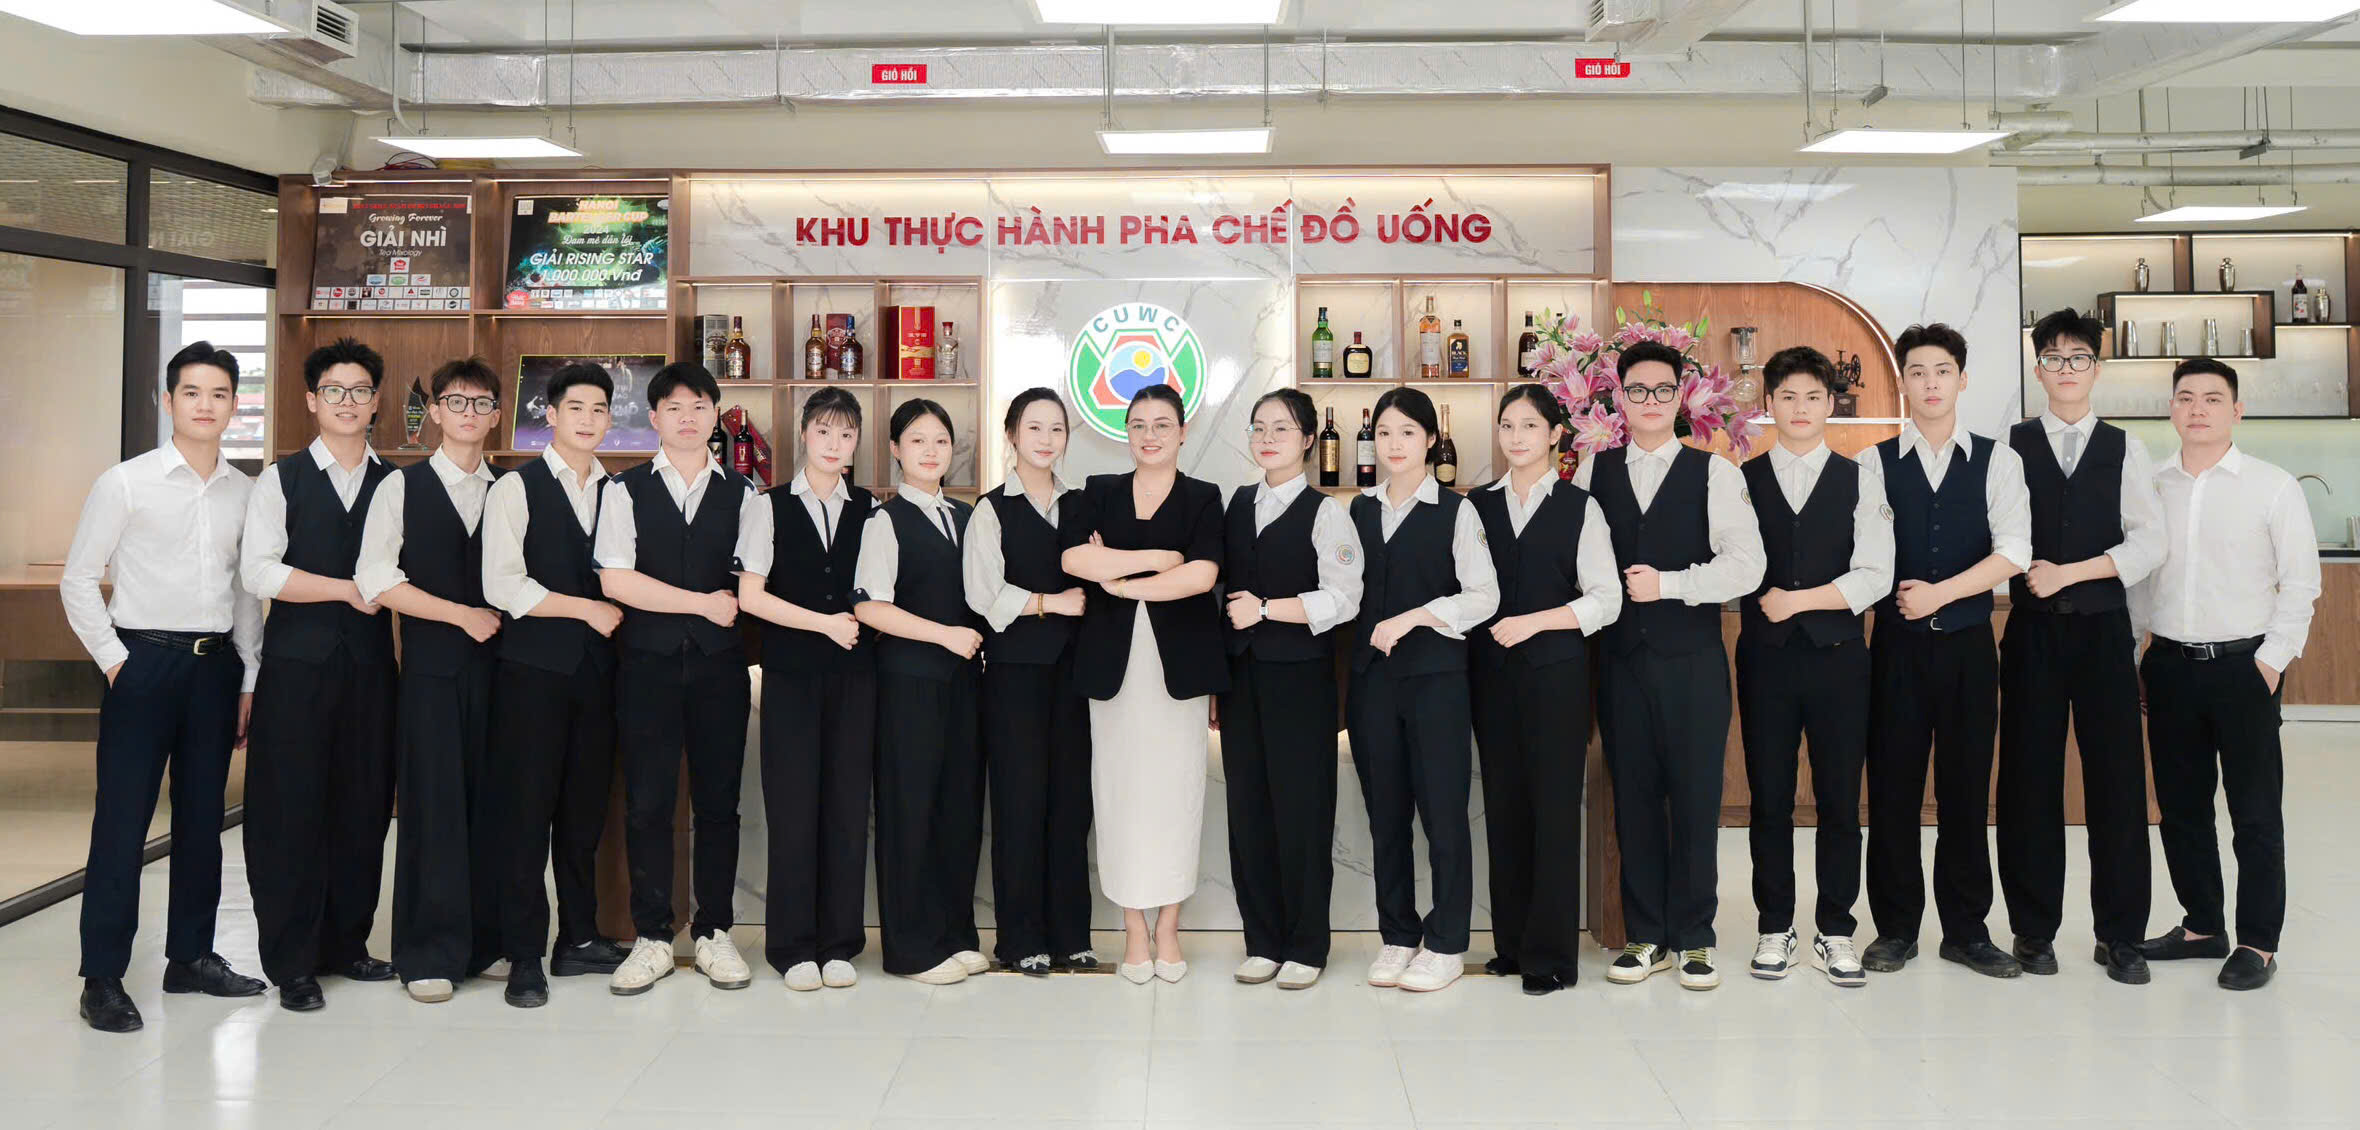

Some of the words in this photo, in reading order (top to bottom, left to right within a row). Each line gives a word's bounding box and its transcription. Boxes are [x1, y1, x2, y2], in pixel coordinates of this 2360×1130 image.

[368, 213, 406, 225] Growing
[408, 213, 443, 222] Forever
[548, 211, 622, 223] BARTEDER
[796, 217, 869, 246] KHU
[884, 212, 984, 254] THỰC
[997, 205, 1105, 245] HÀNH
[1120, 215, 1198, 244] PHA
[1212, 198, 1293, 244] CHẾ
[1300, 197, 1360, 244] ĐỒ
[1377, 197, 1492, 244] UỐNG
[360, 225, 405, 247] GIẢI
[411, 225, 447, 247] NHÌ
[530, 248, 562, 265] GIẢI
[565, 252, 615, 265] RISING
[618, 252, 653, 265] STAR
[1093, 305, 1180, 333] CUWC
